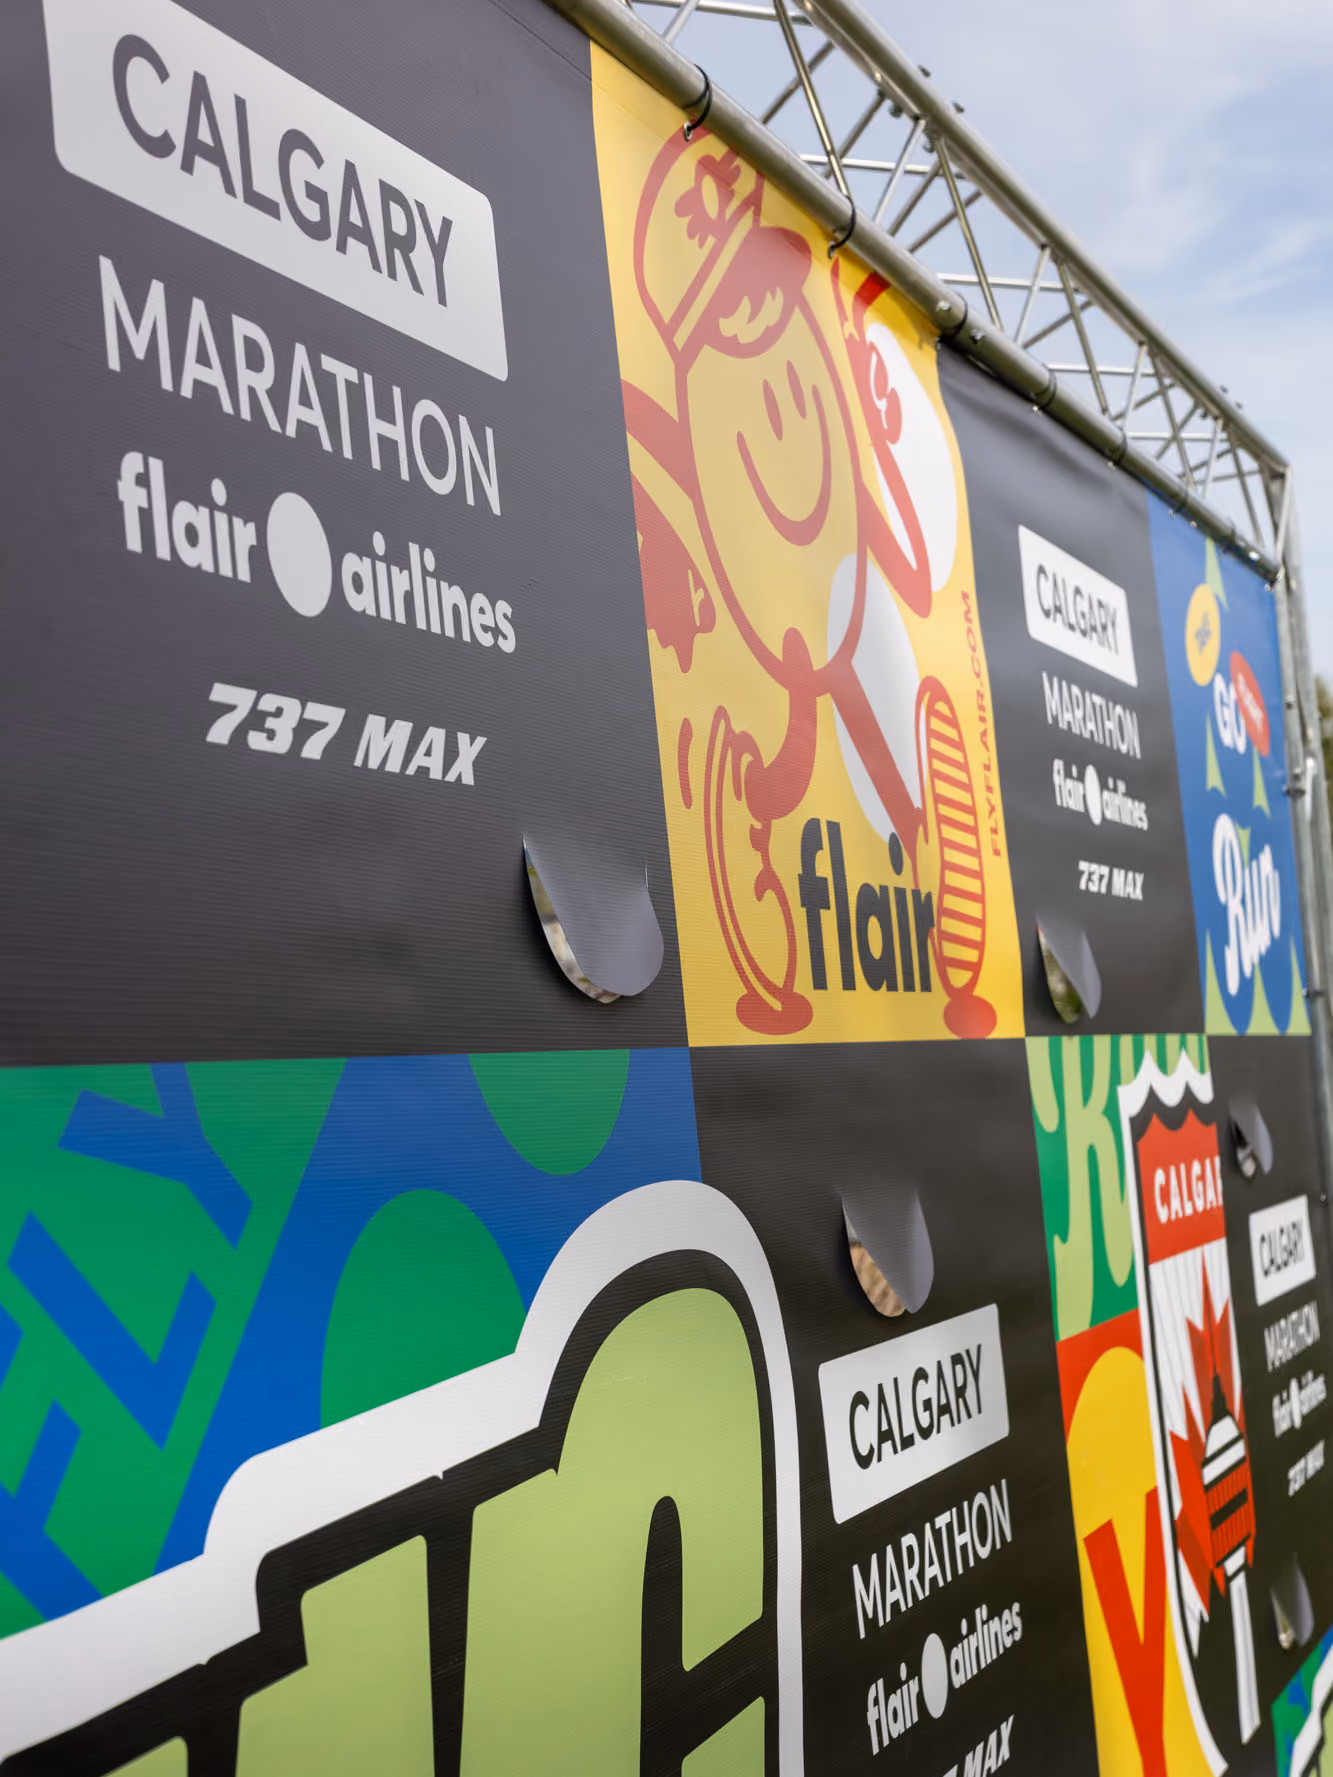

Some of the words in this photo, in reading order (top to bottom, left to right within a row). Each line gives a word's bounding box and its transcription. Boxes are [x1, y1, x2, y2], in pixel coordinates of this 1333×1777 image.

[112, 34, 453, 308] CALGARY
[99, 254, 502, 516] MARATHON
[117, 451, 257, 583] flair
[342, 531, 516, 653] airlines
[1036, 564, 1120, 656] CALGARY
[206, 682, 346, 760] 737
[354, 714, 487, 786] MAX
[961, 590, 1002, 857] FLYFLAIR.COM
[1042, 671, 1141, 759] MARATHON
[1053, 759, 1085, 814] flair
[1102, 777, 1148, 831] airlines
[798, 818, 935, 992] flair
[1078, 861, 1108, 895] 737
[1112, 867, 1144, 900] MAX
[1212, 813, 1281, 997] Run
[849, 1344, 984, 1470] CALGARY
[852, 1479, 1012, 1640] MARATHON
[867, 1663, 919, 1756] flair
[950, 1602, 1022, 1689] airlines
[963, 1714, 1014, 1777] MAX
